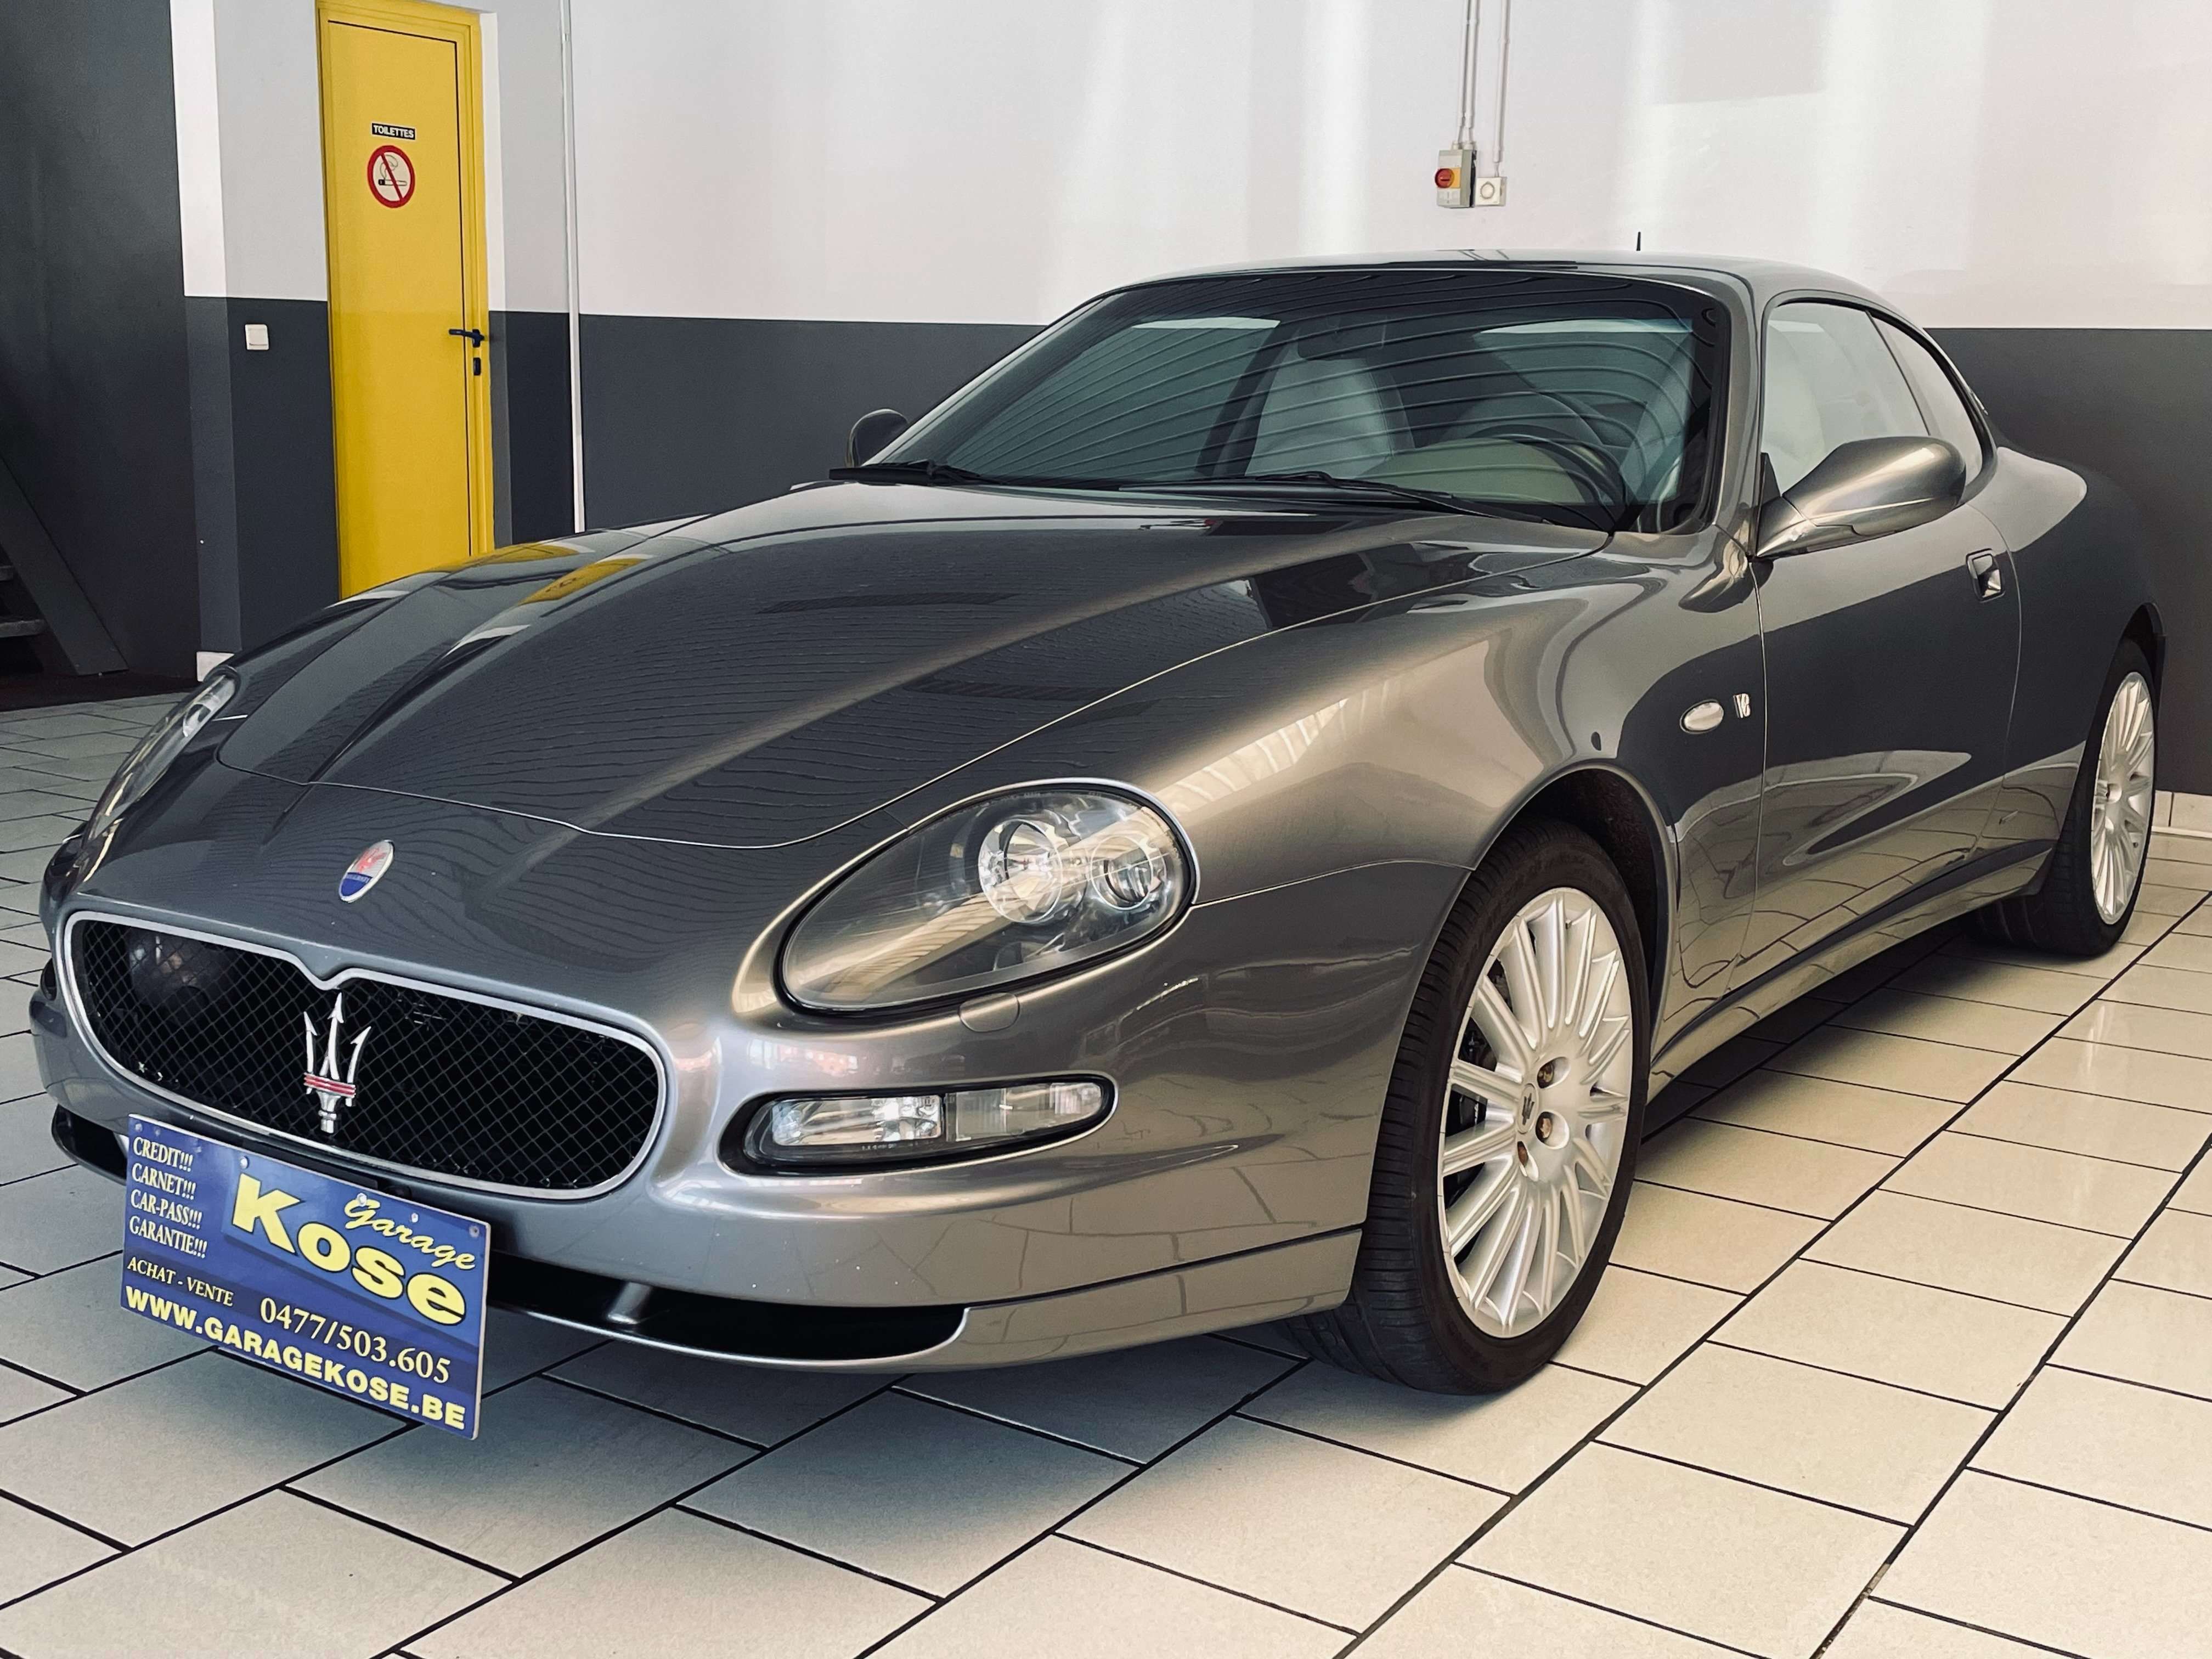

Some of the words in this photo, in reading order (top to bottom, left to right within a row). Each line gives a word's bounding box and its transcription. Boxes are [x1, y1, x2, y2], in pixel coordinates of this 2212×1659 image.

[373, 125, 414, 138] TOILETTES
[133, 1137, 193, 1172] CREDIT!!!
[131, 1163, 196, 1200] CARNET!!!
[130, 1189, 202, 1230] CAR-PASS!!!
[129, 1216, 207, 1259] GARANTIE!!!
[232, 1173, 465, 1325] Kose
[344, 1199, 476, 1270] Garage
[127, 1257, 176, 1285] ACHAT
[186, 1277, 234, 1307] VENTE
[261, 1296, 451, 1384] 0477/503.605
[126, 1285, 465, 1430] WWW.GARAGEKOSE.BE
